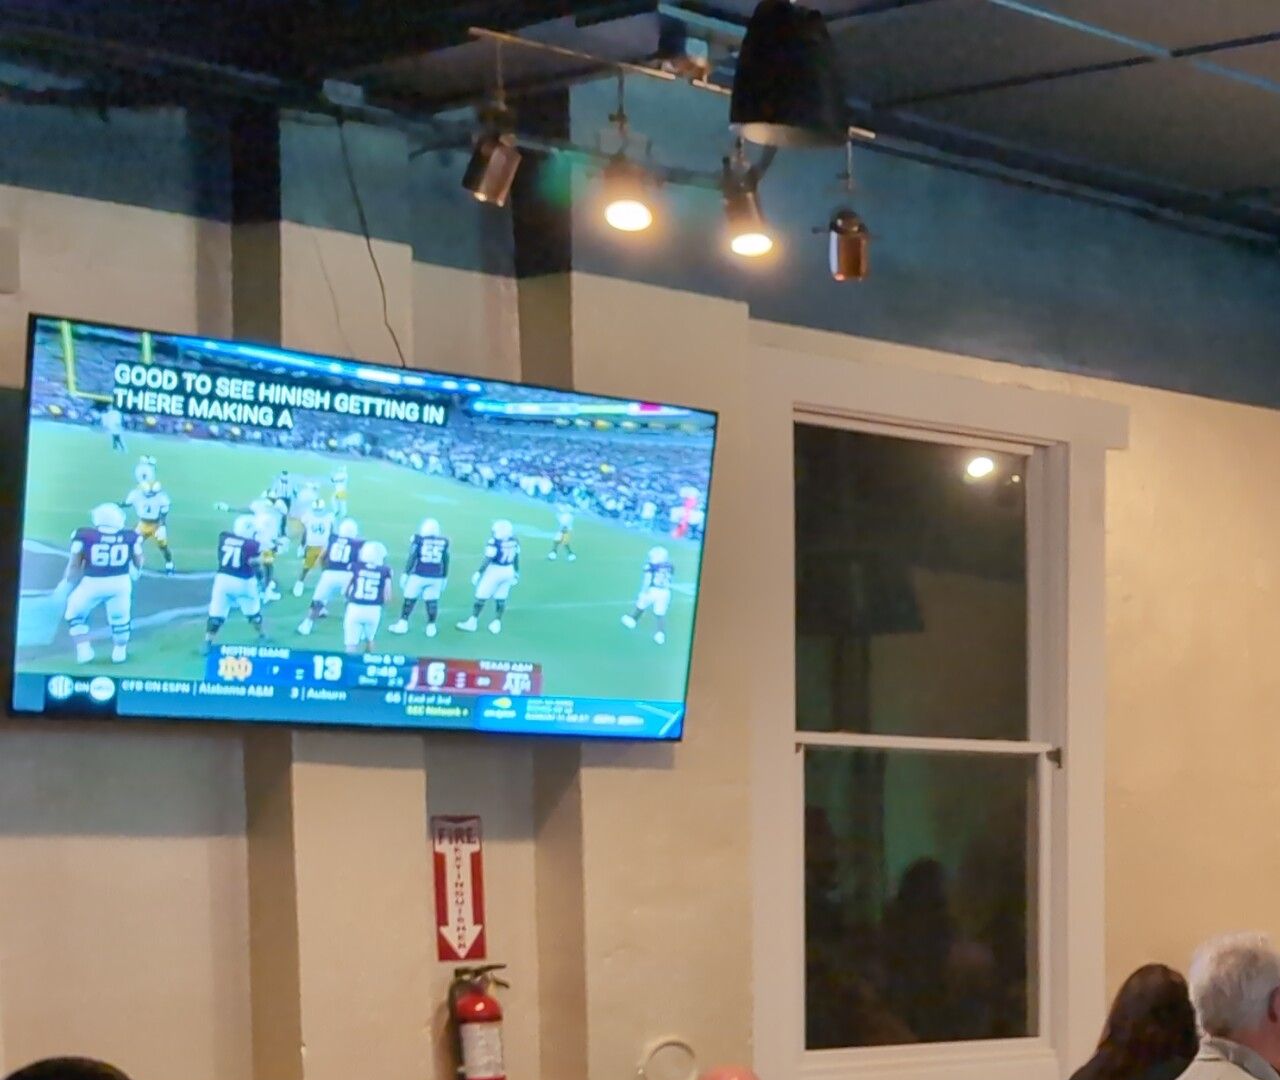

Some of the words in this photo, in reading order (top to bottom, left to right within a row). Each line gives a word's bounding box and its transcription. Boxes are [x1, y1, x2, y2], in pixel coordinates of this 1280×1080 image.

[114, 363, 178, 391] GOOD
[181, 371, 212, 395] TO
[216, 376, 255, 401] SEE
[258, 381, 330, 411] HINISH
[333, 392, 420, 423] GETTING
[423, 405, 445, 425] IN
[113, 388, 184, 417] THERE
[188, 396, 274, 428] MAKING
[277, 408, 294, 430] A
[90, 543, 129, 567] 60
[221, 545, 243, 569] 71
[358, 576, 379, 600] 15
[313, 655, 342, 681] 13
[426, 662, 446, 688] 6
[307, 688, 347, 701] Auburn
[437, 827, 477, 845] FIRE
